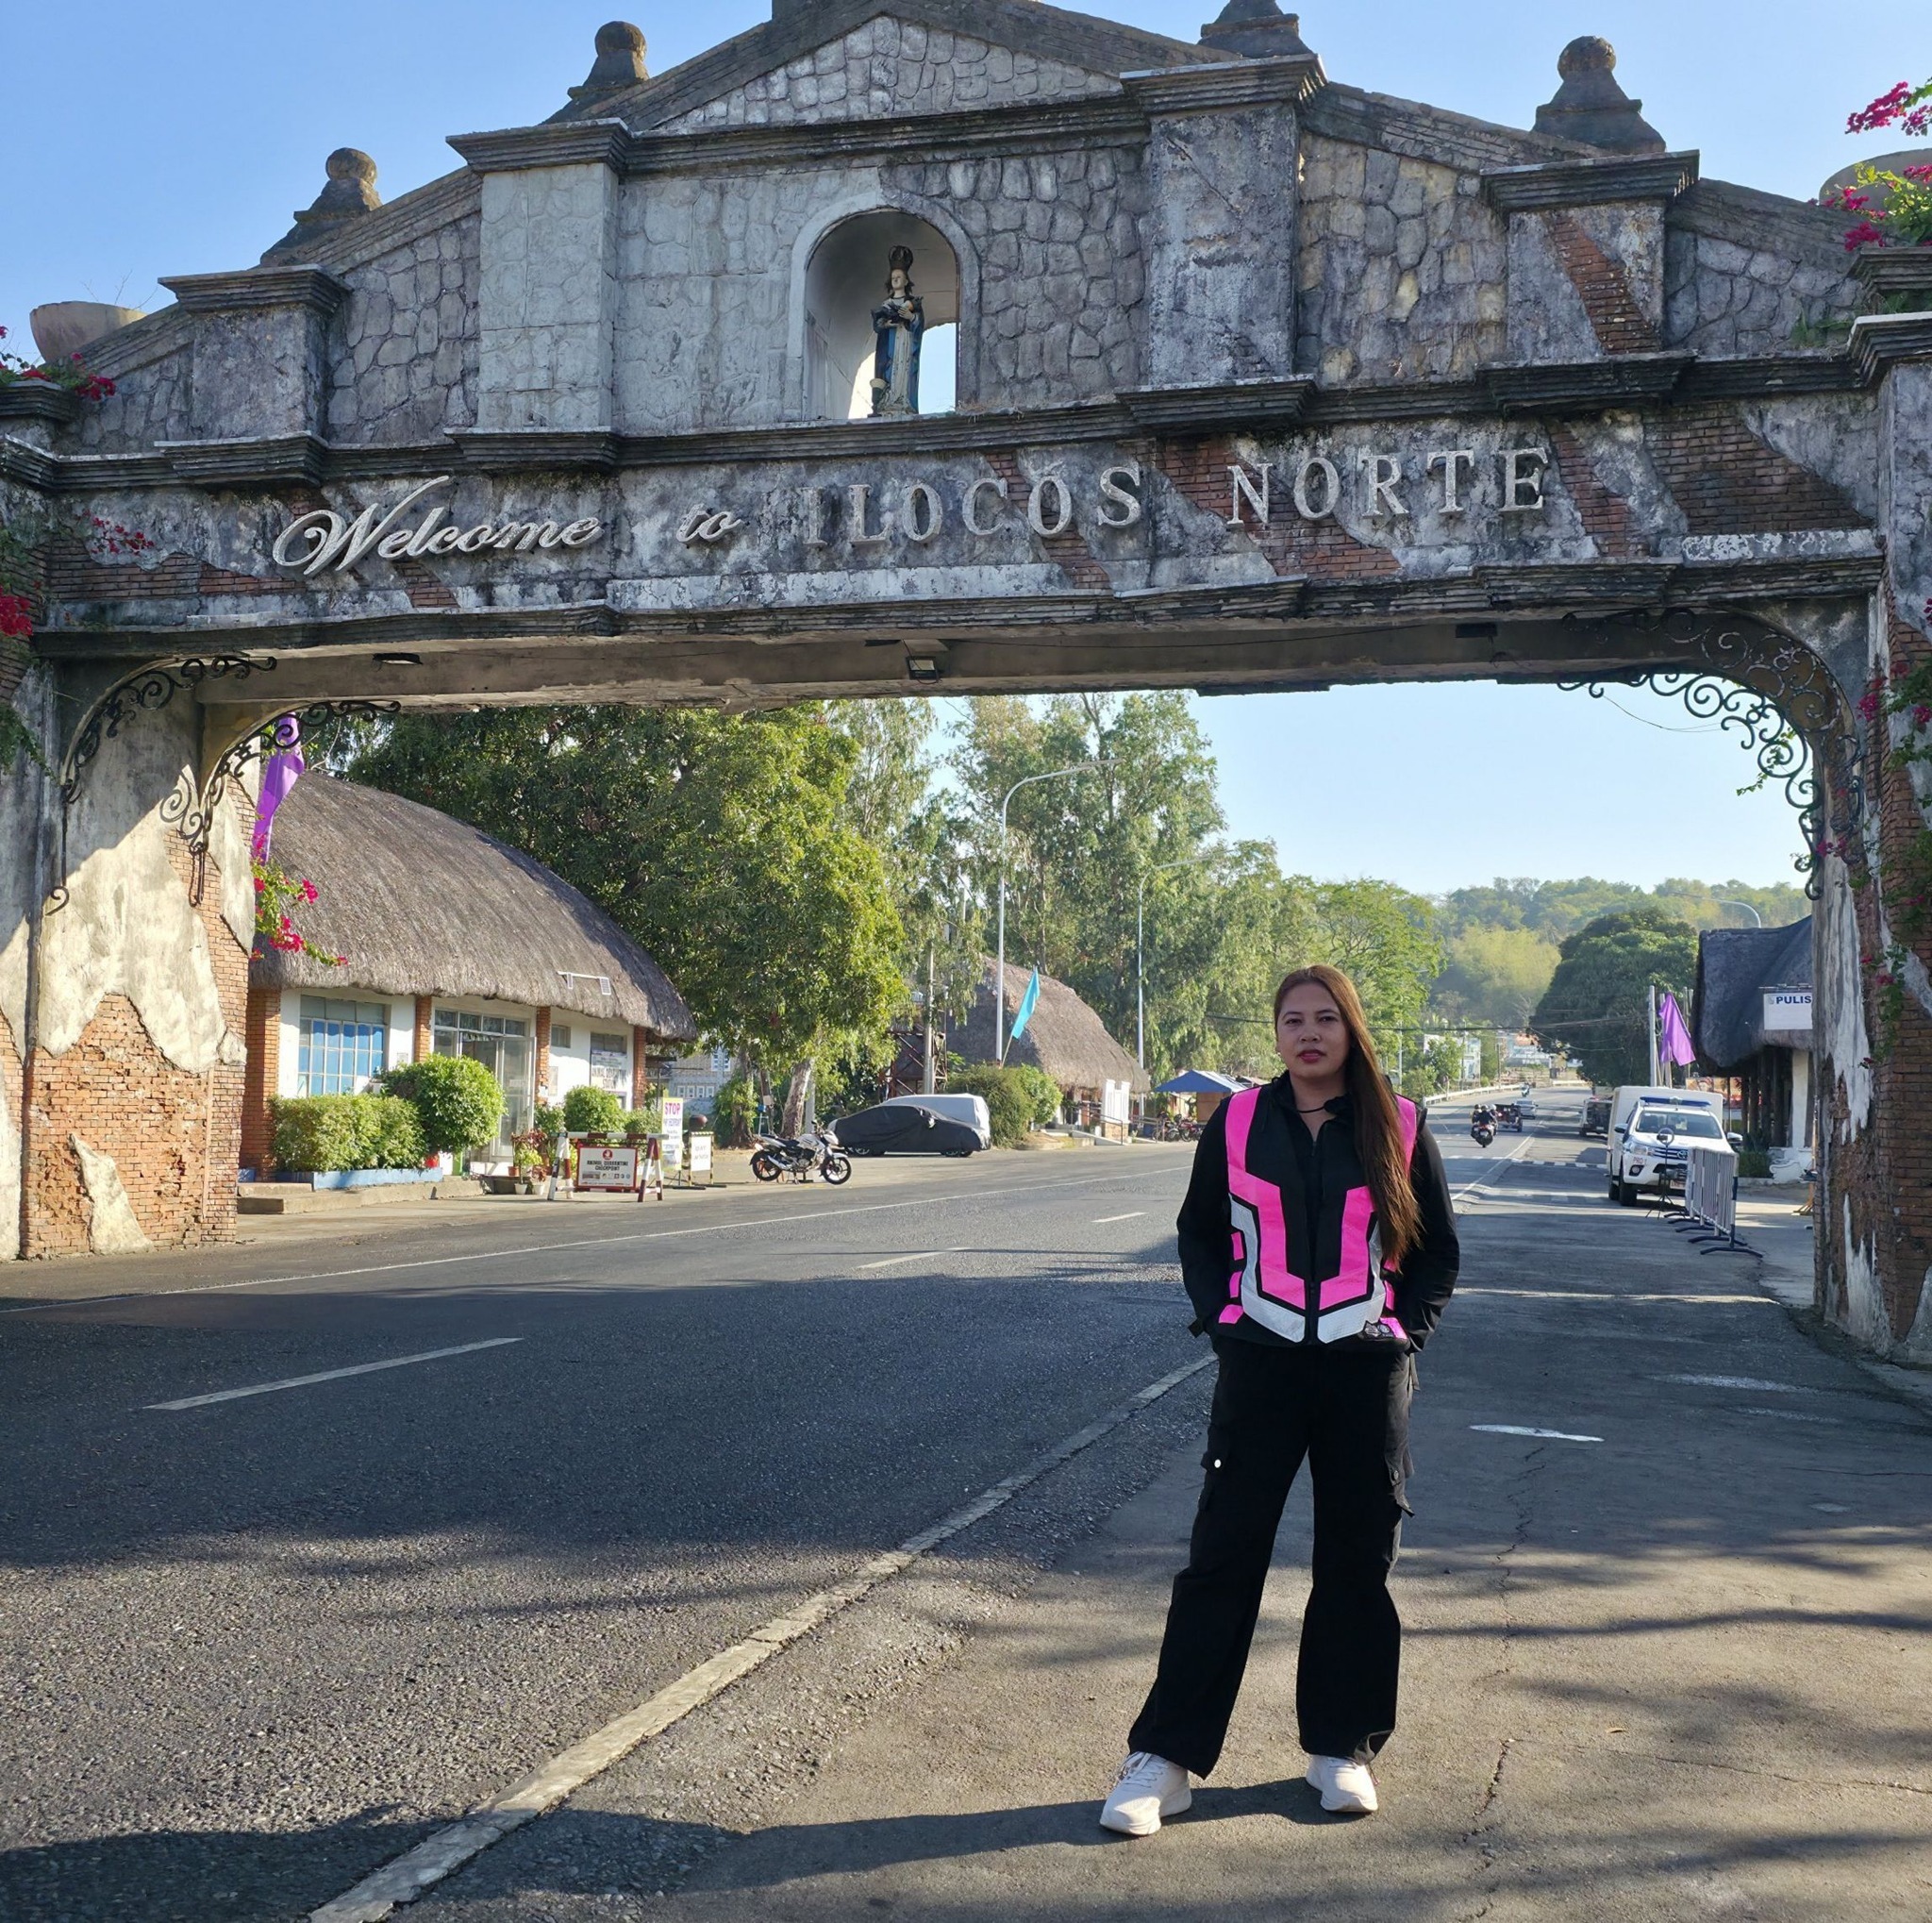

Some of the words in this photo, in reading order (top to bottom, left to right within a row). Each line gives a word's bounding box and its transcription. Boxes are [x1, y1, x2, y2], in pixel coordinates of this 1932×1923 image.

[273, 475, 605, 576] Welcome
[675, 503, 742, 543] to
[800, 460, 1141, 546] ILOCOS
[1227, 446, 1549, 526] NORTE
[1775, 995, 1812, 1005] PULIS
[664, 1102, 681, 1115] STOP
